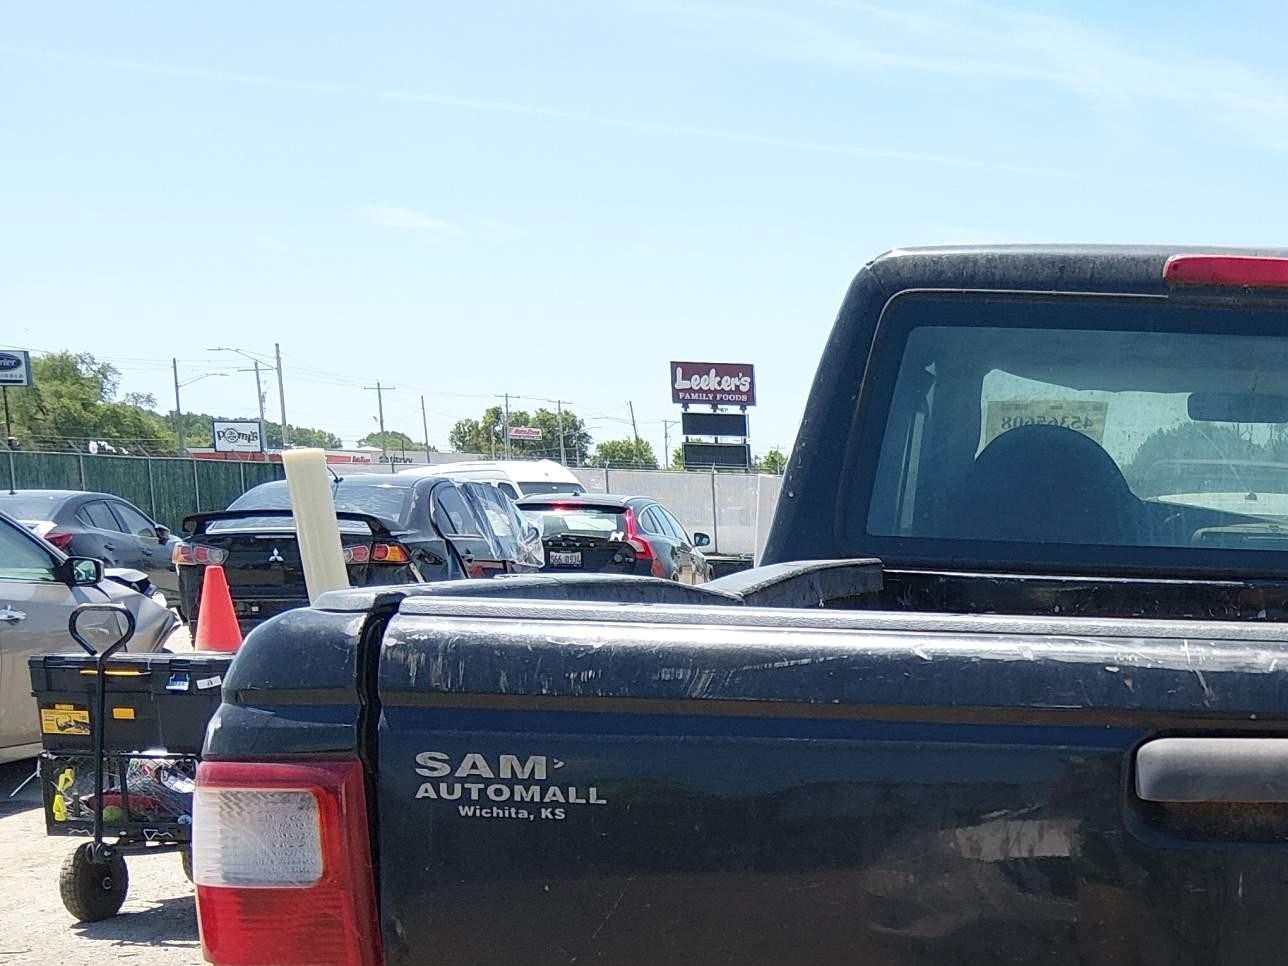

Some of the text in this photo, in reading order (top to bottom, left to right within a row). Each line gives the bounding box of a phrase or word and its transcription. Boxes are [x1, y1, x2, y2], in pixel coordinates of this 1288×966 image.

[675, 366, 751, 392] Leeker's
[679, 392, 747, 401] FAMILY FOODS
[415, 751, 547, 780] SAM
[415, 782, 607, 805] AUTOMALL
[458, 805, 566, 821] Wichita, KS
